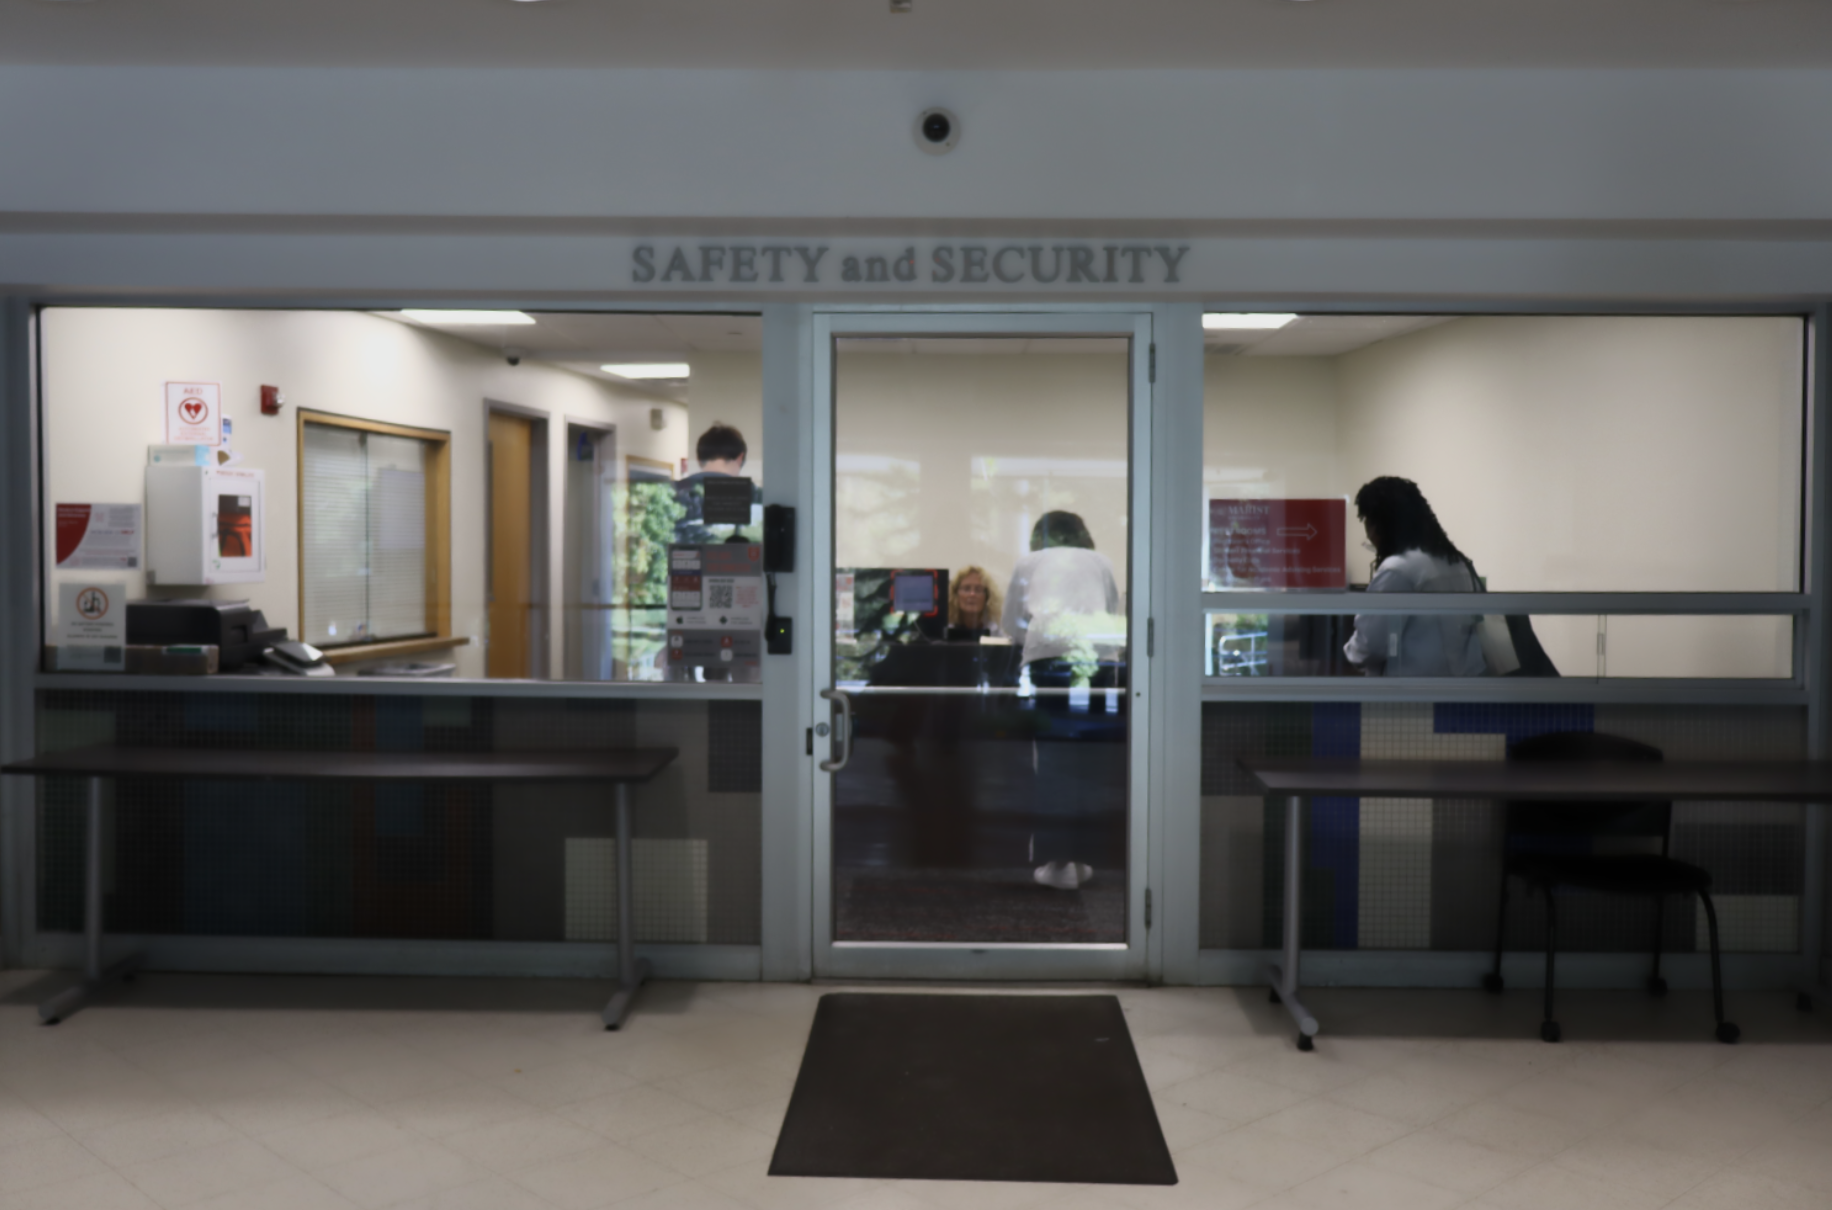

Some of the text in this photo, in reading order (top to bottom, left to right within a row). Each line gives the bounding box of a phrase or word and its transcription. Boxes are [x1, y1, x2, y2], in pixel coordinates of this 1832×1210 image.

[631, 245, 1191, 283] SAFETY and SECURITY
[183, 387, 203, 395] AED
